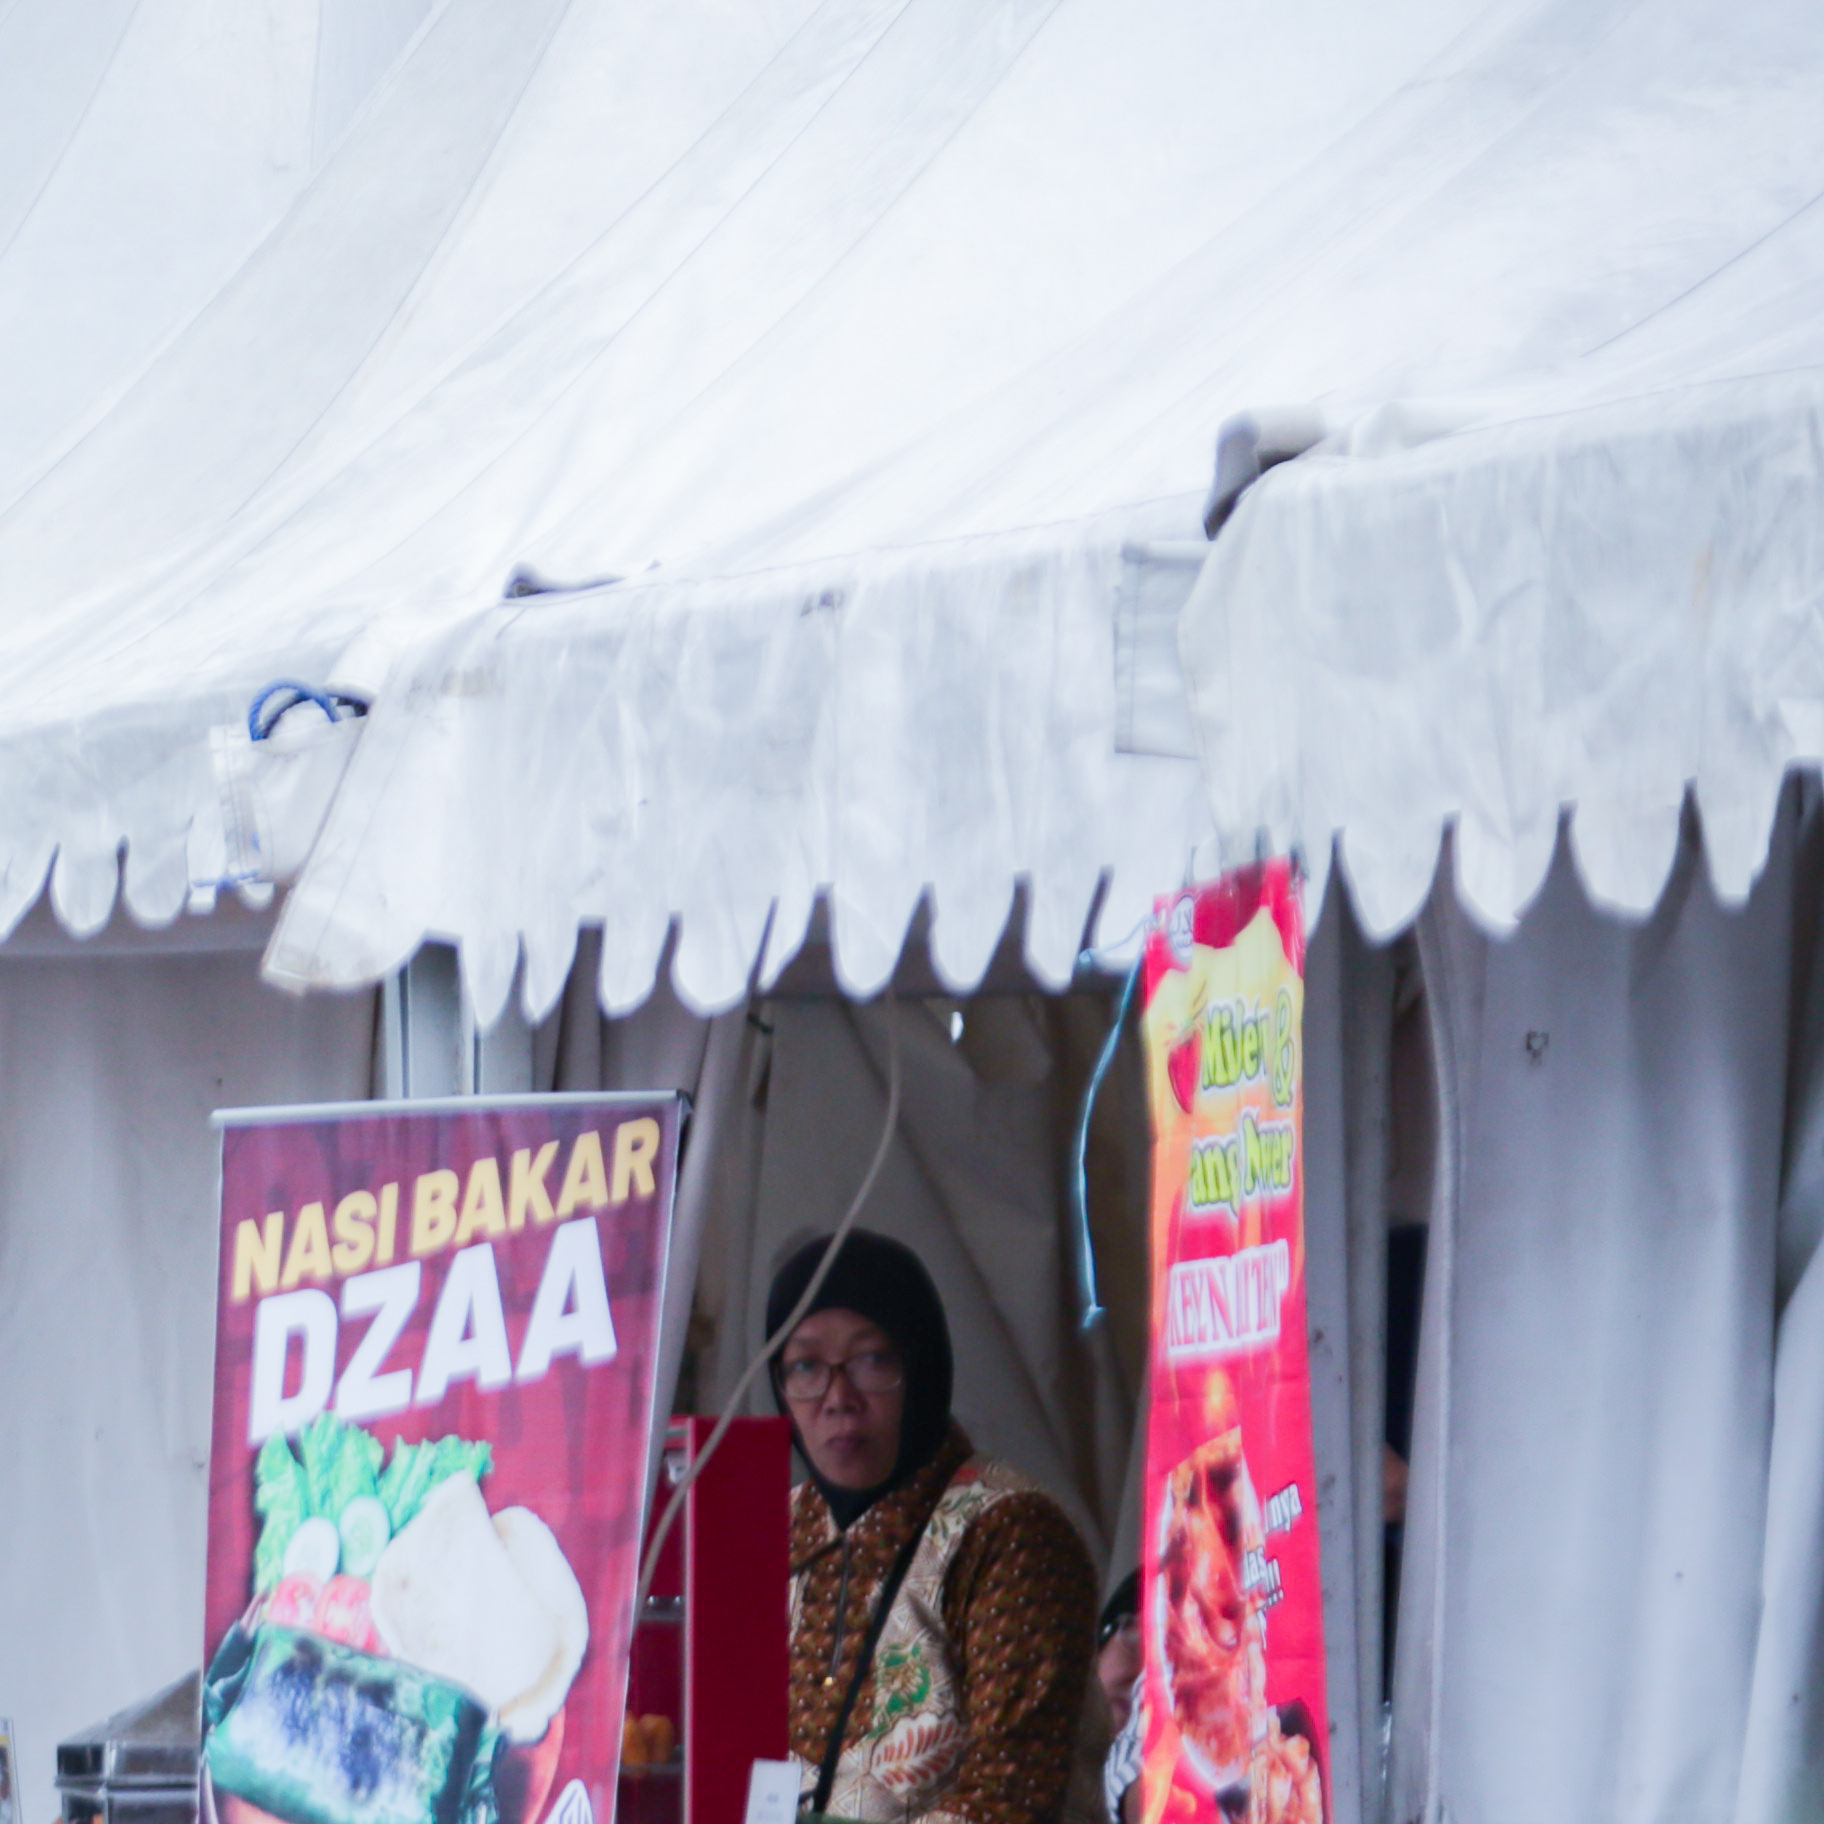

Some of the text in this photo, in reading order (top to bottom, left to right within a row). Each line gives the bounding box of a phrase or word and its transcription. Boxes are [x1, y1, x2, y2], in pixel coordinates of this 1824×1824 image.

[233, 1117, 660, 1301] NASI BAKAR
[248, 1216, 618, 1444] DZAA
